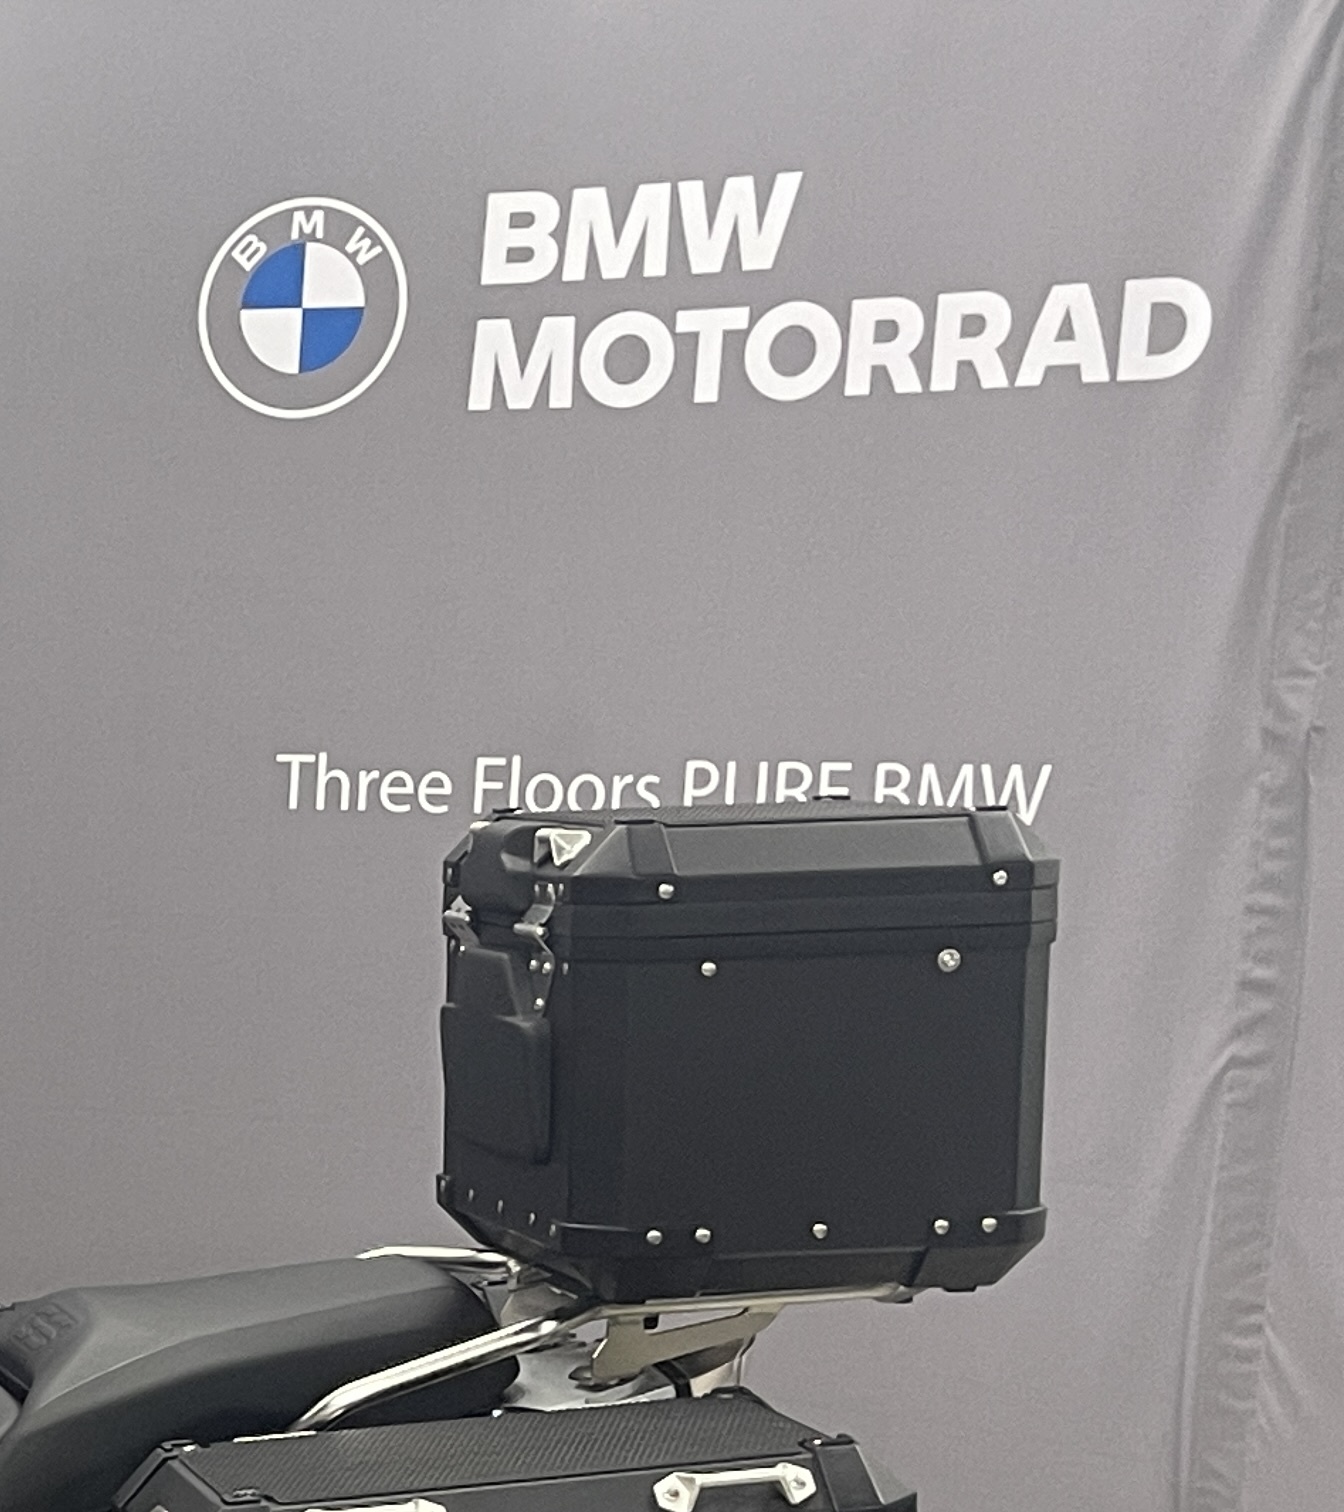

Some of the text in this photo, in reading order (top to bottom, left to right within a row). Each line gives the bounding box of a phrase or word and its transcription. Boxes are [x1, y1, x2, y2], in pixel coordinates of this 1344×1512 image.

[230, 208, 384, 273] BMW
[479, 170, 804, 286] BMW
[466, 276, 1214, 411] MOTORRAD
[274, 750, 454, 814] Three
[472, 753, 662, 815] Floors
[873, 761, 1054, 827] BMW
